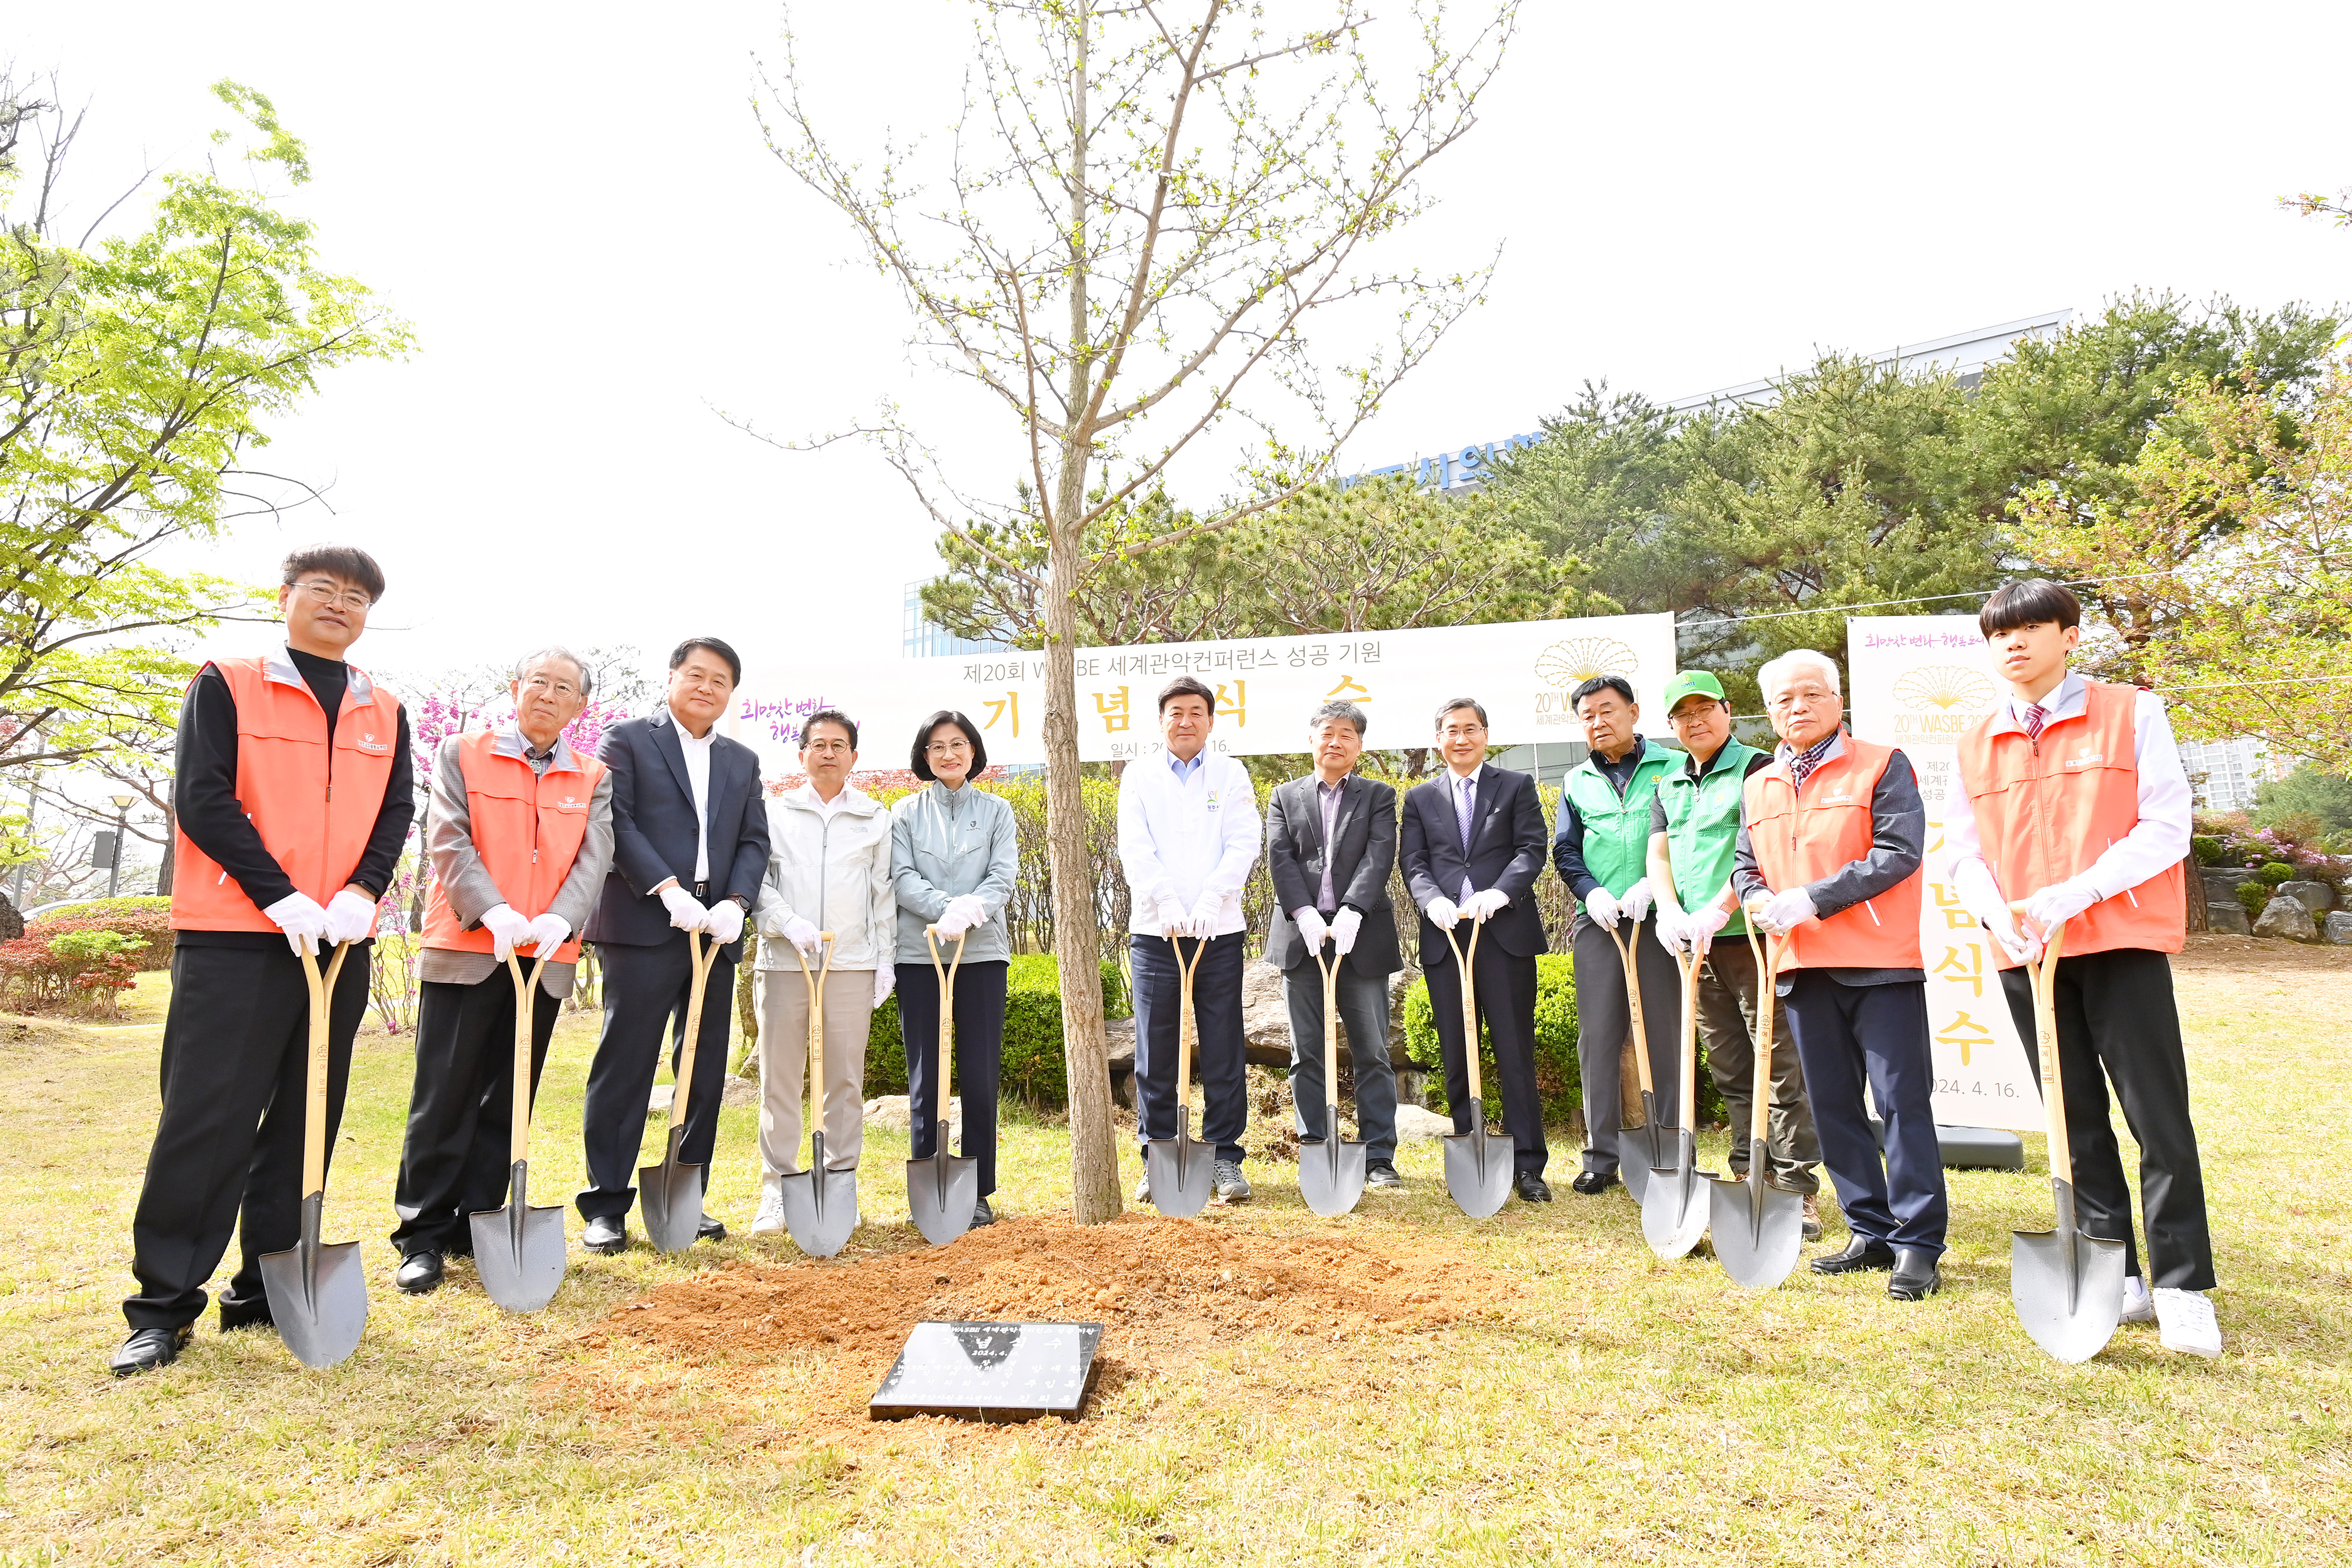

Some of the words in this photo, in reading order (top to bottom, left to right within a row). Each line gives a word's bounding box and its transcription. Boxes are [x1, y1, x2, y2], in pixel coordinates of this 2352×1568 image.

[1865, 634, 1907, 648] 희망찬
[963, 661, 1024, 684] 제20회
[1107, 648, 1278, 677] 세계관악컨퍼런스
[1287, 644, 1329, 667] 성공
[1339, 641, 1381, 664] 기원
[740, 697, 793, 722] 희망찬
[1919, 714, 1965, 733] WASBE
[1111, 742, 1138, 758] 일시
[1921, 788, 1946, 801] 성공
[1994, 1082, 2020, 1098] 16.
